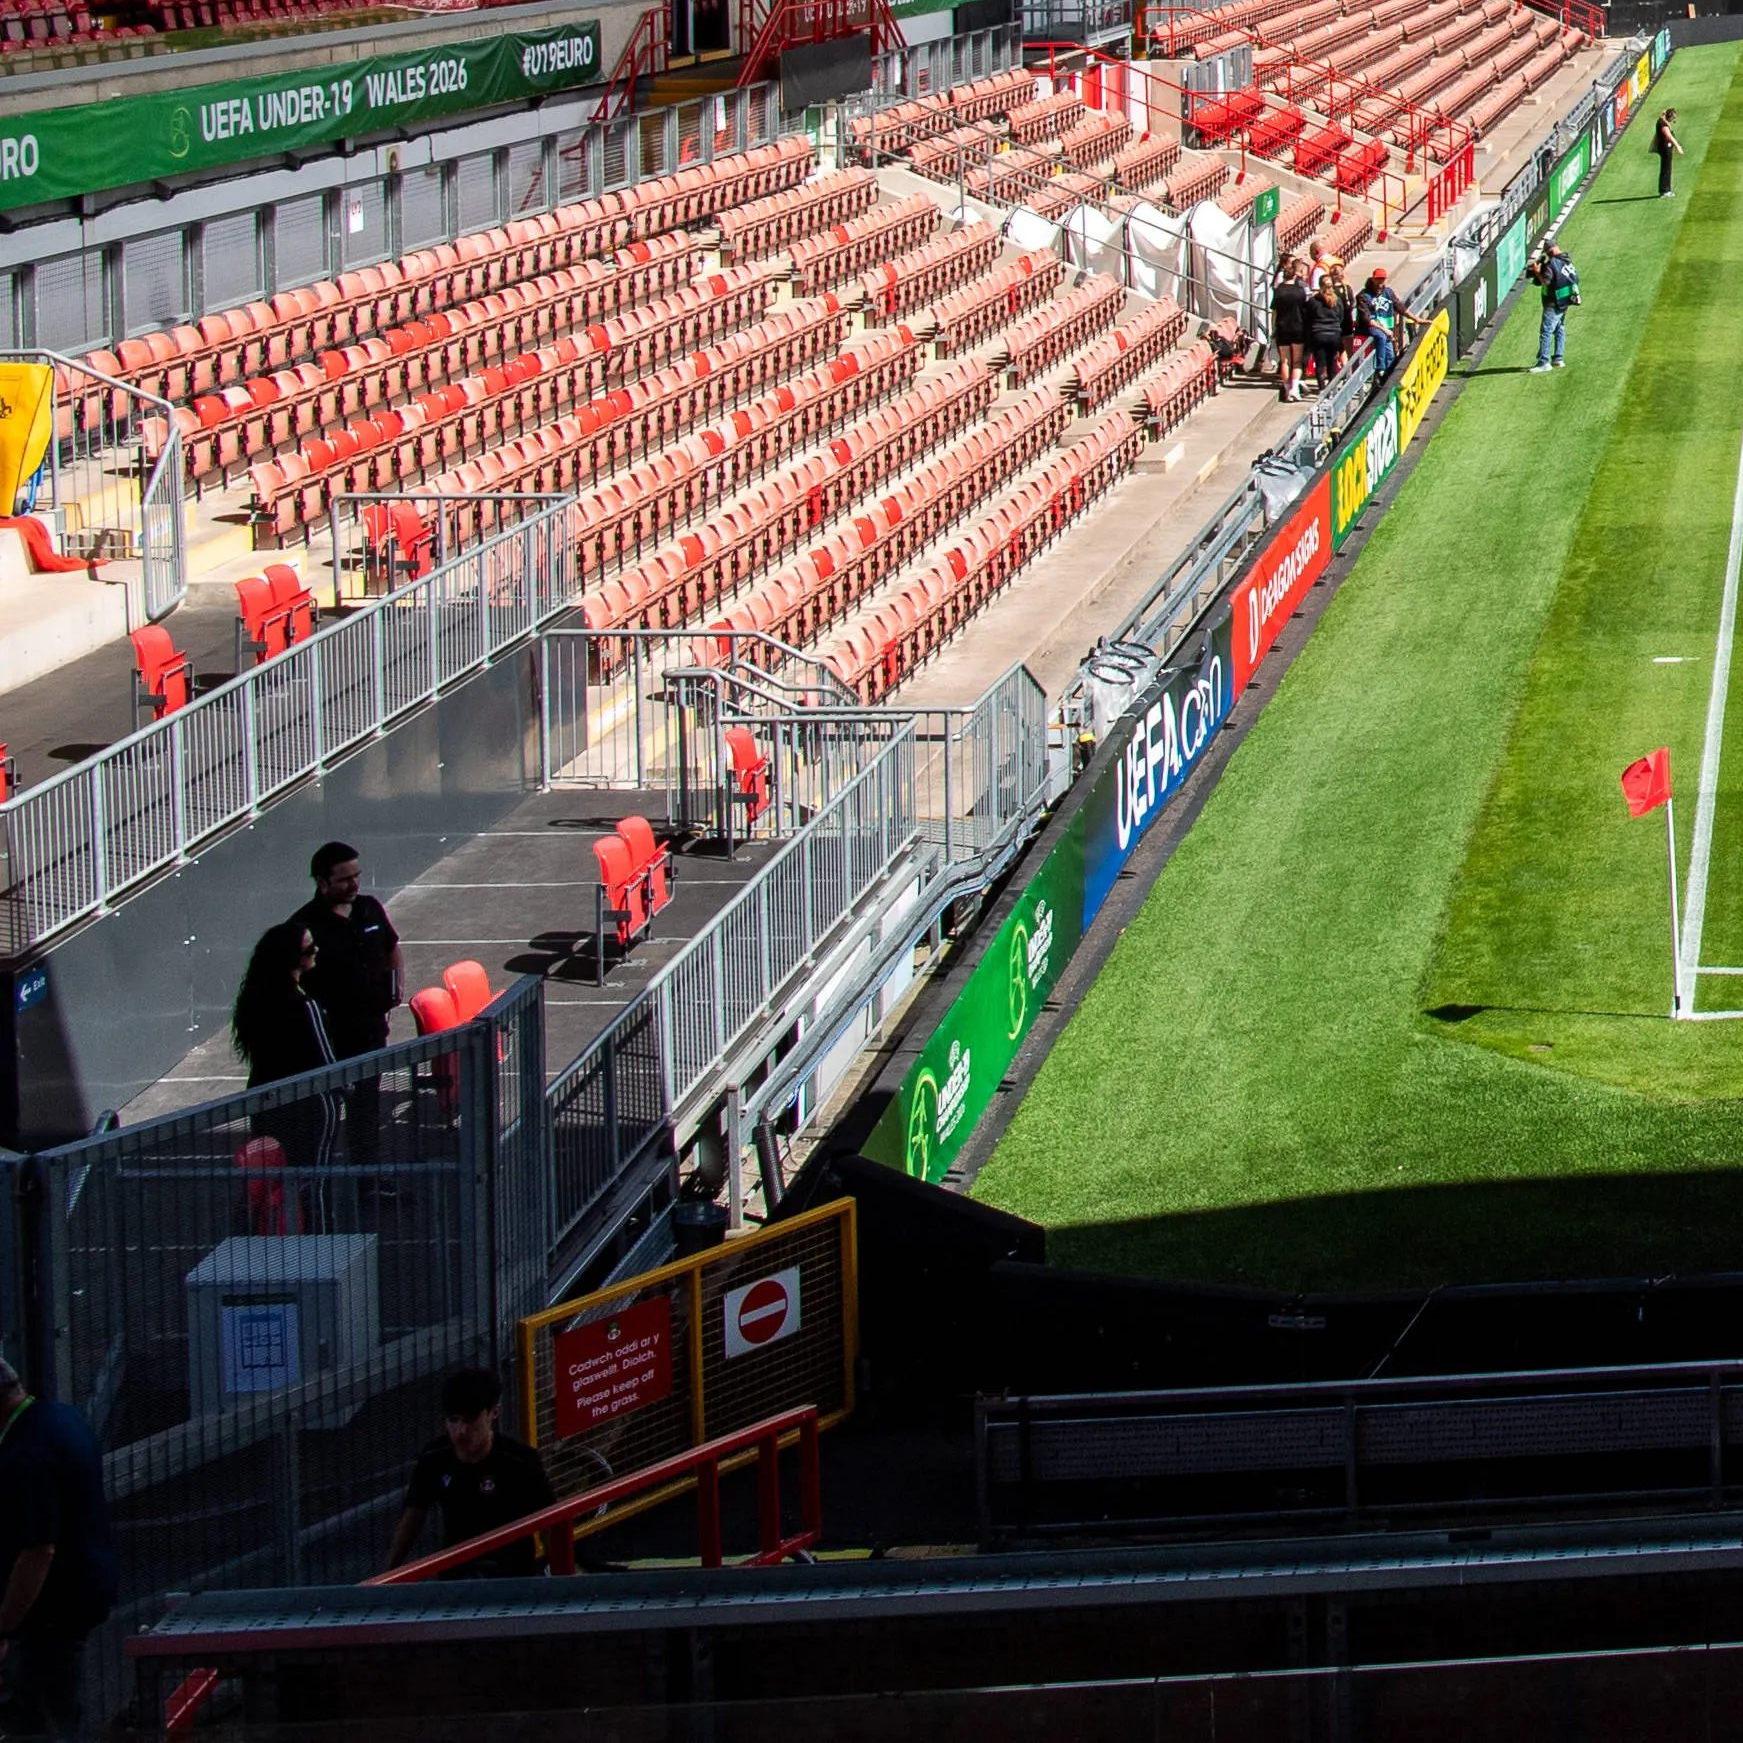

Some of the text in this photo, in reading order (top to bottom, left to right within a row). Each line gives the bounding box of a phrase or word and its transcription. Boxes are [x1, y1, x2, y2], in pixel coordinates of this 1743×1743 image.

[201, 35, 594, 143] UEFA UNDER-19 WALES 2026 #U19EURO
[1261, 550, 1297, 625] DRAGON
[1296, 517, 1320, 576] SIGNS
[568, 1332, 660, 1377] Cadwch oddi ar y
[572, 1350, 657, 1392] glaswellt. Diolch.
[576, 1368, 655, 1409] Please keep off
[591, 1393, 640, 1418] the grass.
